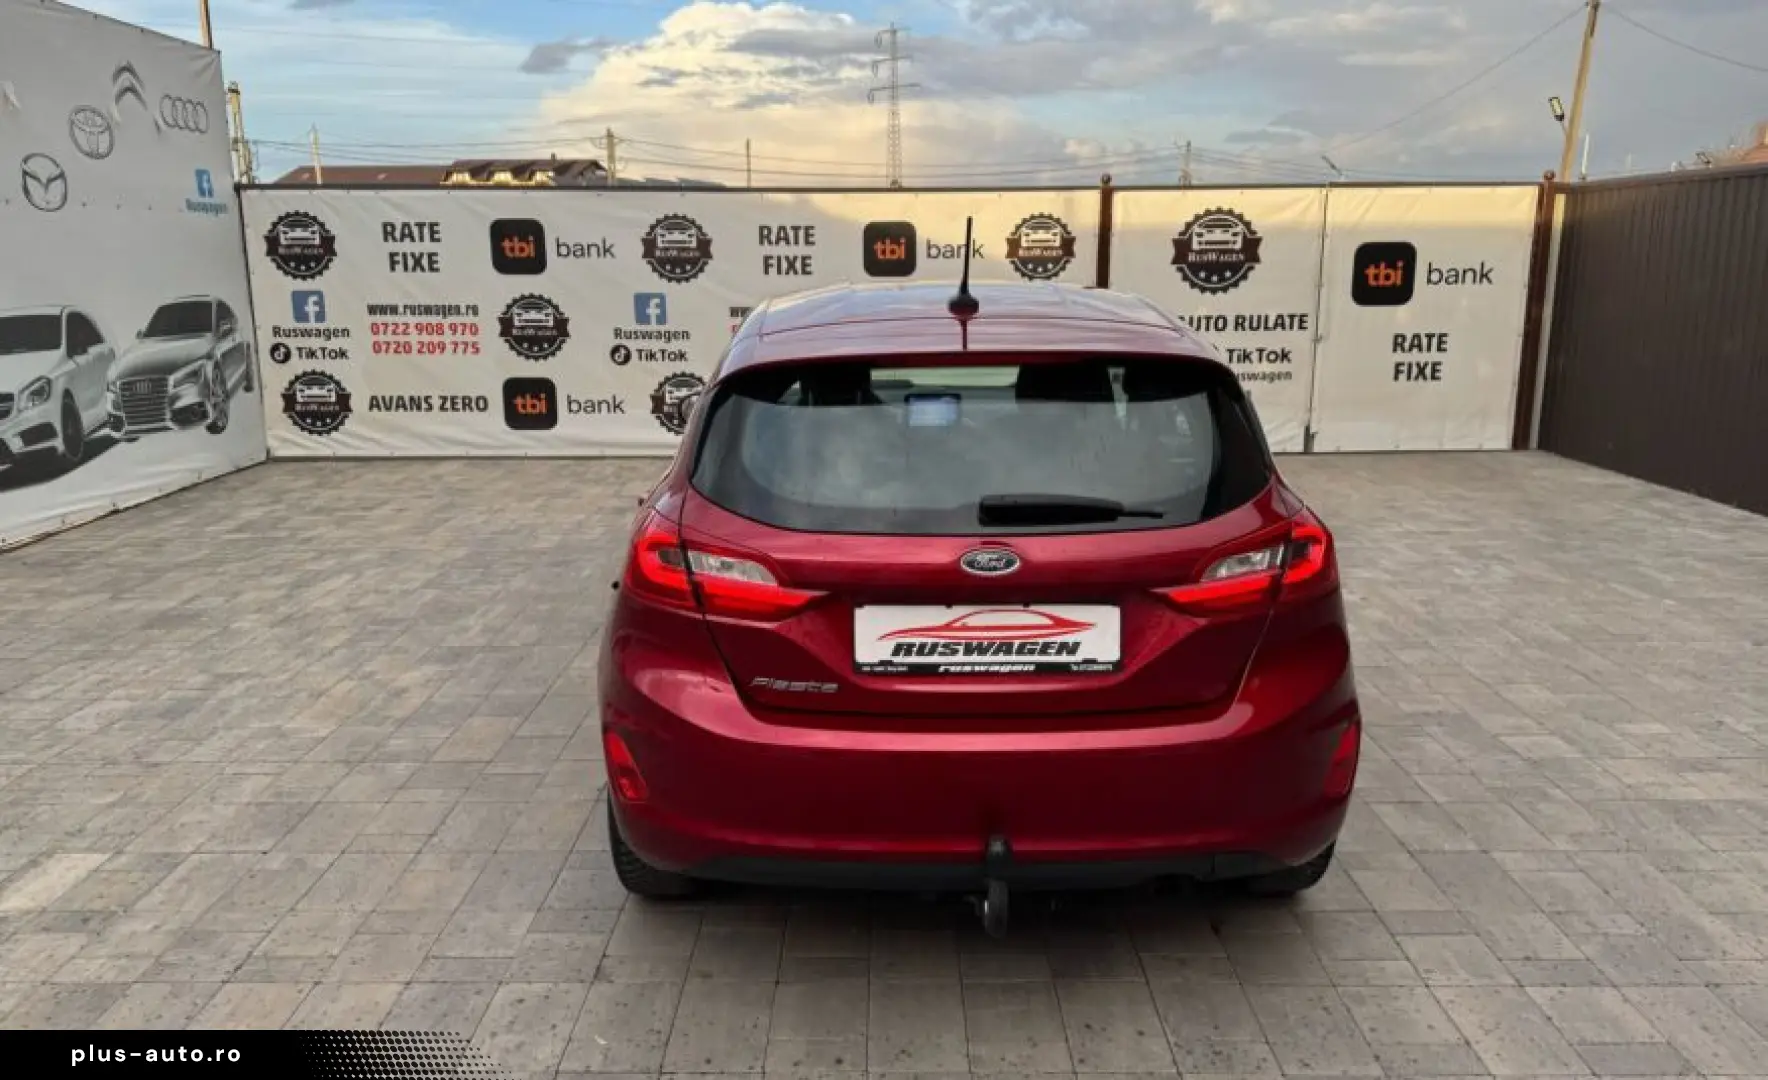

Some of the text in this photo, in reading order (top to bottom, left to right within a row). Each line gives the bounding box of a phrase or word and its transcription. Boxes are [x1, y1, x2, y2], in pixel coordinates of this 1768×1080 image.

[382, 222, 441, 243] RATE
[758, 225, 815, 246] RATE
[502, 236, 616, 258] tbi bank
[874, 239, 906, 260] tbi
[388, 252, 441, 273] FIXE
[763, 255, 813, 275] FIXE
[1364, 261, 1494, 287] tbi bank
[367, 304, 479, 318] www.ruswagen.ro
[371, 323, 479, 336] 0722 908 970
[1178, 313, 1308, 332] UTO RULATE
[272, 326, 350, 341] Ruswagen
[614, 327, 690, 342] Ruswagen
[1393, 333, 1448, 353] RATE
[296, 347, 350, 360] TikTok
[372, 341, 480, 354] 0720 209 775
[636, 349, 688, 362] TikTok
[1226, 348, 1292, 364] TikTok
[1394, 362, 1442, 382] FIXE
[368, 395, 489, 412] AVANS ZERO
[514, 392, 625, 414] tbi bank
[892, 641, 1080, 657] RUSWAGEN
